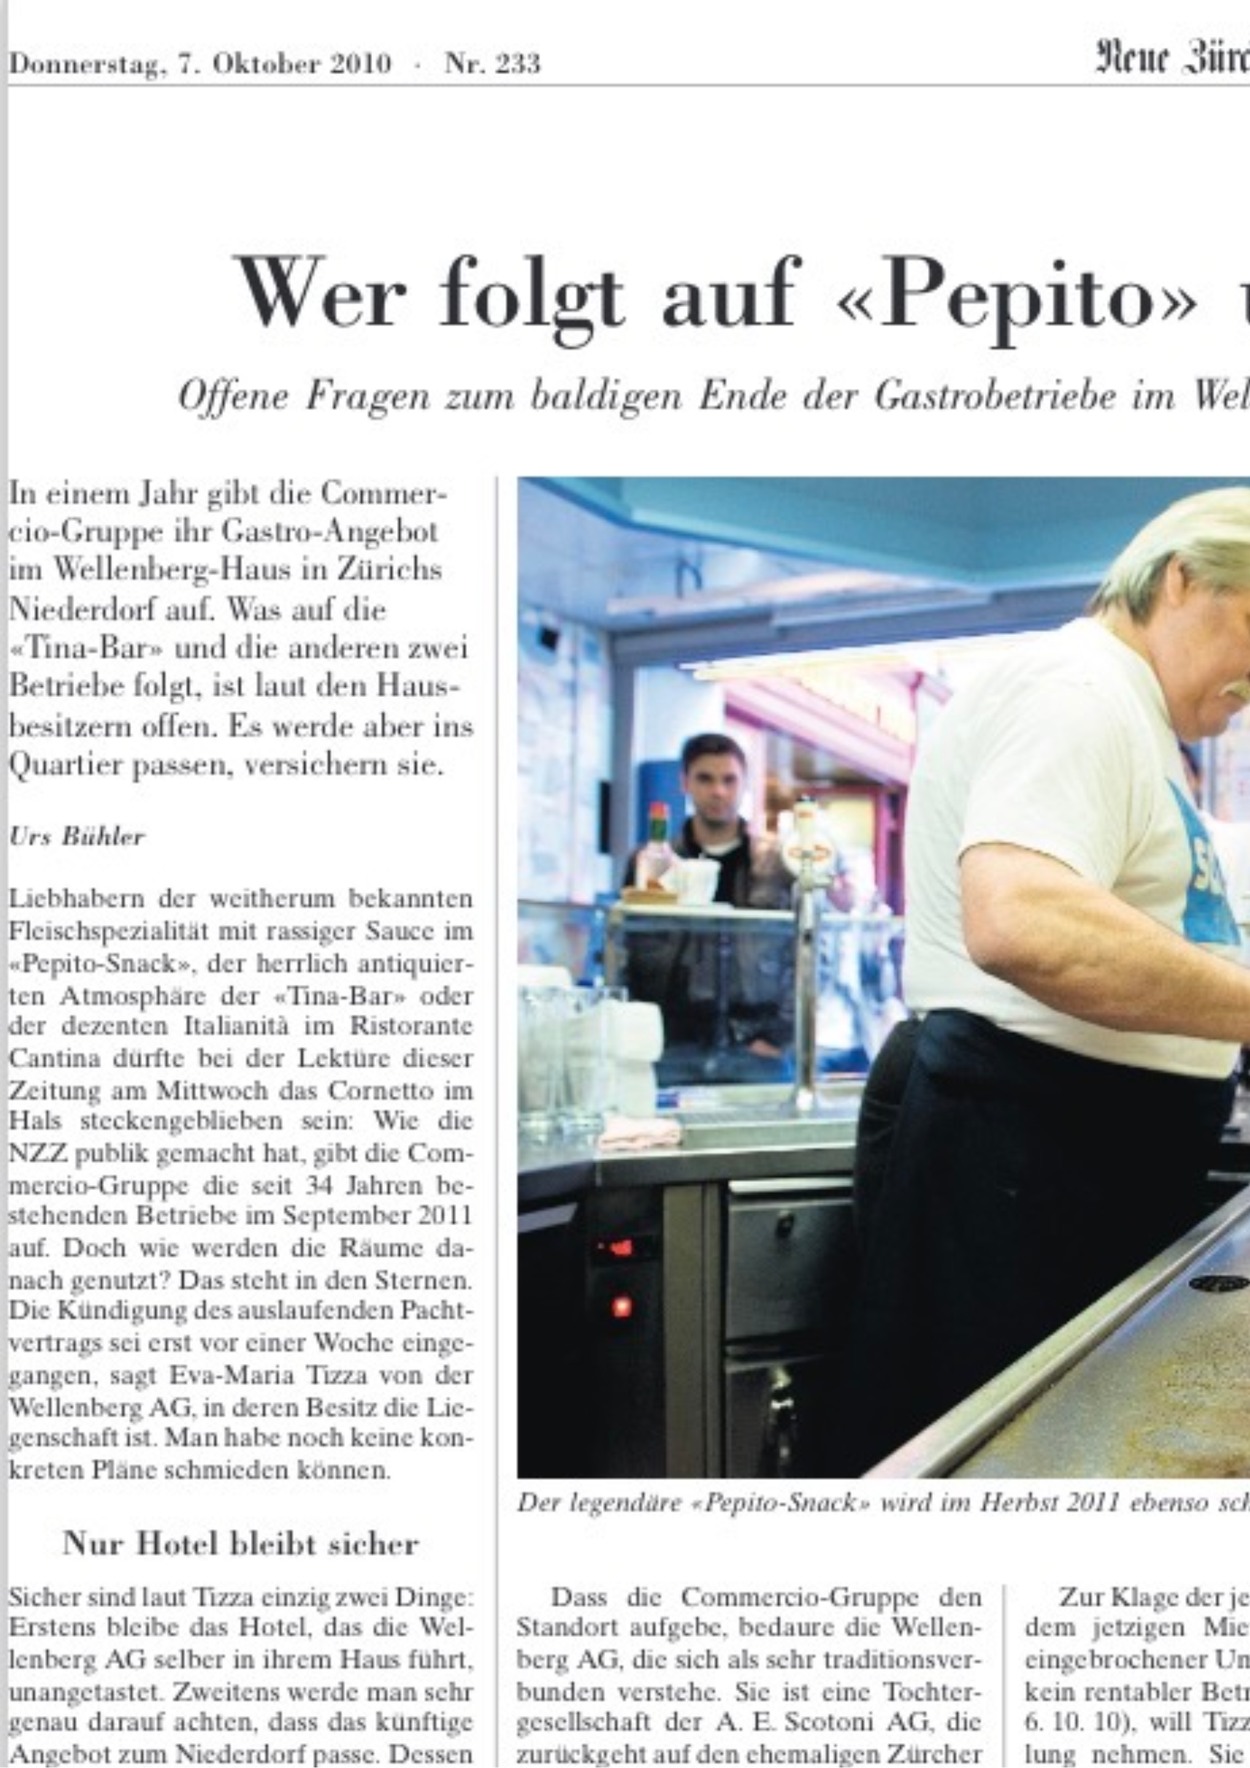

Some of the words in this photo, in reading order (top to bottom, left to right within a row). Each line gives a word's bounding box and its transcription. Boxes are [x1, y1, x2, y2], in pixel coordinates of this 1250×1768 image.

[9, 50, 167, 81] Donnerstag,
[178, 51, 201, 75] 7.
[212, 50, 322, 75] Oktober
[329, 52, 392, 75] 2010
[445, 50, 486, 75] Nr.
[494, 52, 541, 75] 233
[1095, 37, 1171, 74] Neue
[231, 254, 408, 329] Wer
[438, 253, 627, 351] folgt
[662, 253, 804, 329] auf
[836, 254, 1198, 351] «Pepito»
[178, 376, 289, 421] Offene
[305, 377, 429, 421] Fragen
[444, 389, 515, 411] zum
[530, 375, 683, 421] baldigen
[698, 376, 788, 411] Ende
[802, 376, 860, 410] der
[874, 376, 1117, 411] Gastrobetriebe
[1132, 378, 1176, 411] im
[9, 478, 37, 505] In
[45, 478, 130, 505] einem
[138, 478, 199, 508] Jahr
[207, 478, 259, 513] gibt
[269, 478, 312, 505] die
[321, 478, 448, 505] Commer-
[8, 516, 164, 551] cio-Gruppe
[174, 516, 214, 543] ihr
[221, 515, 438, 551] Gastro-Angebot
[9, 555, 43, 581] im
[53, 553, 291, 589] Wellenberg-Haus
[302, 555, 328, 581] in
[337, 553, 443, 581] Zürichs
[9, 594, 159, 622] Niederdorf
[165, 595, 215, 622] auf.
[226, 595, 282, 622] Was
[291, 595, 337, 622] auf
[343, 594, 386, 622] die
[10, 632, 163, 660] «Tina-Bar»
[175, 632, 227, 660] und
[235, 632, 278, 660] die
[288, 632, 400, 660] anderen
[408, 633, 468, 660] zwei
[9, 670, 126, 698] Betriebe
[134, 670, 202, 705] folgt,
[213, 671, 245, 698] ist
[255, 670, 306, 698] laut
[315, 670, 367, 698] den
[377, 670, 460, 698] Haus-
[9, 711, 132, 738] besitzern
[141, 711, 218, 738] offen.
[229, 711, 263, 738] Es
[272, 711, 354, 738] werde
[362, 710, 425, 738] aber
[434, 711, 475, 738] ins
[8, 749, 124, 784] Quartier
[132, 759, 234, 784] passen,
[245, 748, 388, 776] versichern
[397, 749, 444, 776] sie.
[9, 825, 52, 846] Urs
[61, 824, 146, 847] Bühler
[9, 887, 145, 909] Liebhabern
[158, 887, 197, 909] der
[209, 887, 336, 909] weitherum
[348, 887, 473, 909] bekannten
[9, 919, 209, 948] Fleischspezialität
[218, 920, 257, 941] mit
[266, 920, 357, 948] rassiger
[365, 920, 435, 941] Sauce
[444, 920, 474, 941] im
[516, 1491, 562, 1513] Der
[570, 1491, 683, 1518] legendäre
[691, 1491, 871, 1518] «Pepito-Snack»
[881, 1491, 933, 1513] wird
[940, 1492, 971, 1513] im
[980, 1491, 1060, 1513] Herbst
[1066, 1491, 1120, 1513] 2011
[1130, 1491, 1209, 1513] ebenso
[63, 1529, 125, 1556] Nur
[137, 1529, 218, 1556] Hotel
[229, 1529, 317, 1556] bleibt
[327, 1529, 420, 1556] sicher
[8, 1586, 82, 1608] Sicher
[87, 1586, 137, 1608] sind
[142, 1586, 187, 1608] laut
[192, 1586, 254, 1608] Tizza
[261, 1586, 331, 1614] einzig
[335, 1587, 389, 1607] zwei
[395, 1586, 473, 1613] Dinge:
[551, 1586, 608, 1608] Dass
[626, 1586, 662, 1608] die
[681, 1586, 920, 1614] Commercio-Gruppe
[938, 1586, 983, 1608] den
[1059, 1586, 1106, 1608] Zur
[1111, 1586, 1180, 1613] Klage
[1185, 1586, 1225, 1608] der
[516, 1616, 619, 1637] Standort
[630, 1615, 728, 1643] aufgebe,
[738, 1615, 835, 1637] bedaure
[844, 1616, 881, 1637] die
[891, 1615, 982, 1637] Wellen-
[1025, 1615, 1077, 1637] dem
[1092, 1616, 1186, 1643] jetzigen
